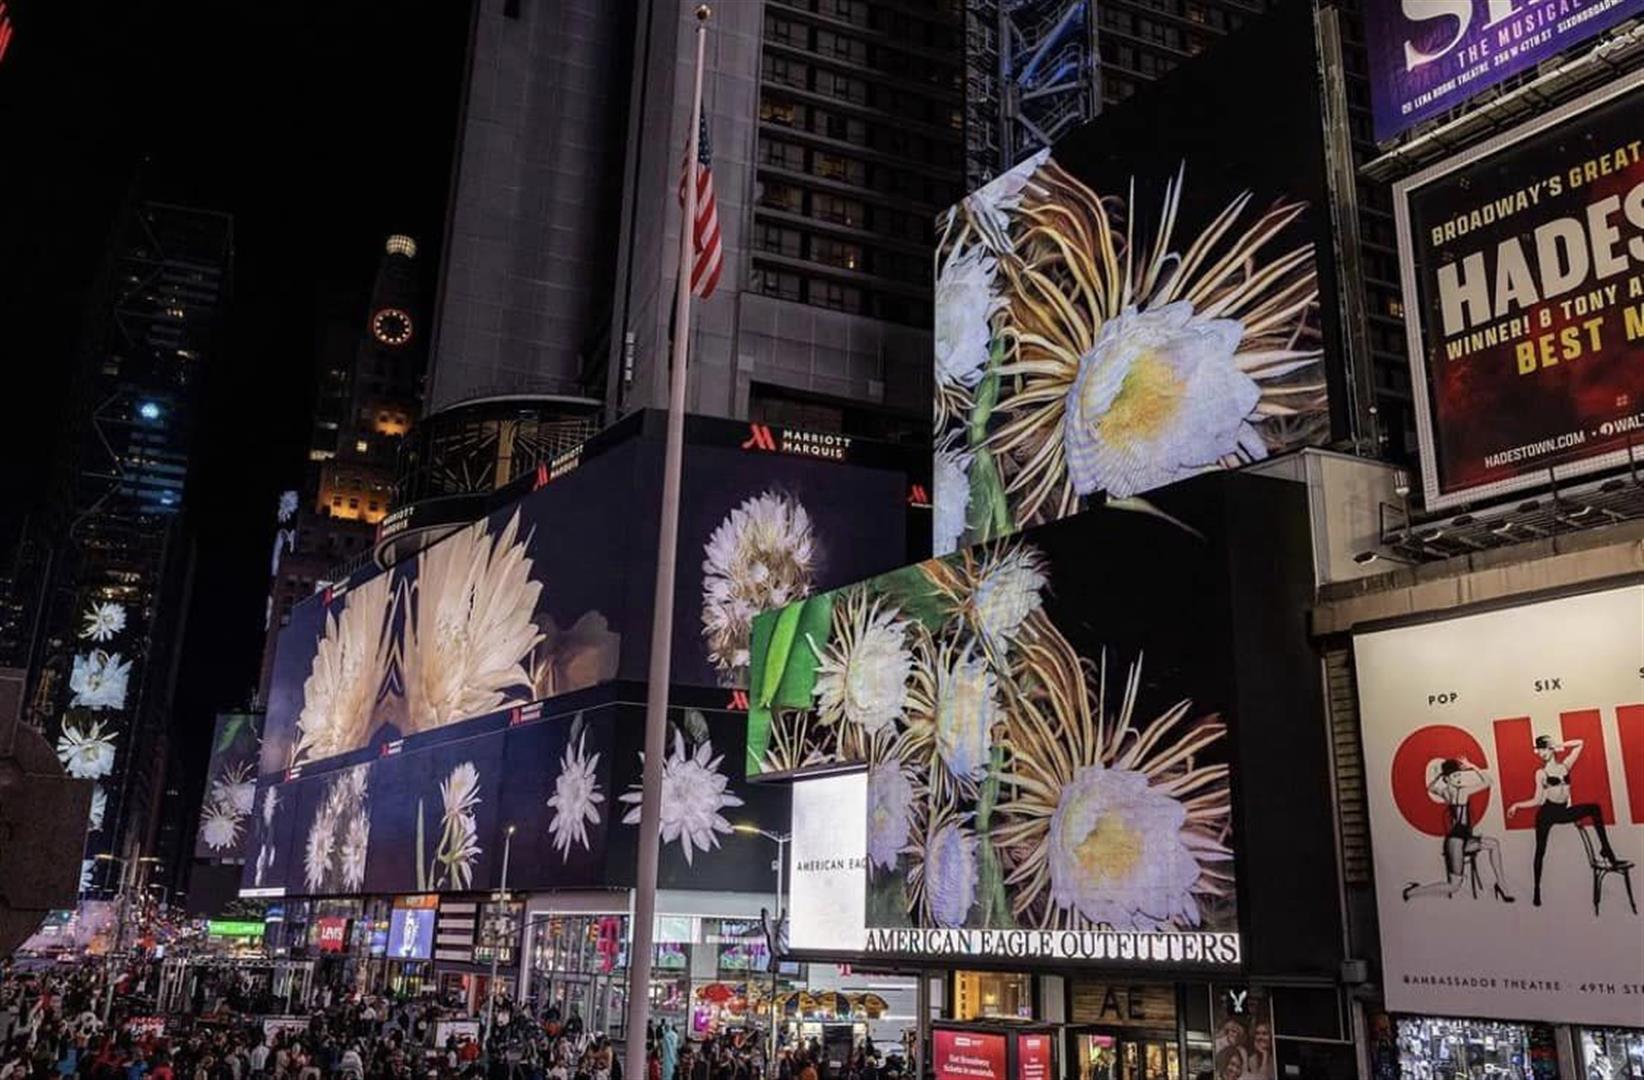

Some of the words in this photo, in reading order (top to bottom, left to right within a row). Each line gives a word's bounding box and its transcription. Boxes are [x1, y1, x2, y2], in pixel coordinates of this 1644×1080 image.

[1458, 38, 1489, 68] THE
[1497, 0, 1581, 47] MUSICAL
[1431, 176, 1563, 247] BROADWAY'S
[1568, 140, 1642, 189] GREAT
[1446, 315, 1531, 361] WINNER!
[1560, 284, 1618, 321] TONY
[1628, 276, 1644, 299] A
[1515, 317, 1604, 376] BEST
[783, 430, 851, 447] MARRIOTT
[783, 442, 843, 458] MARQUIS
[1484, 430, 1586, 469] HADESTOWN.COM
[1428, 693, 1458, 706] POP
[1534, 678, 1562, 692] SIX
[797, 859, 844, 871] AMERICAN
[866, 931, 972, 953] AMERICAN
[981, 934, 1055, 957] EAGLE
[1060, 935, 1238, 963] OUTFITTERS
[1412, 976, 1497, 988] AMBASSADOR
[1504, 979, 1561, 991] THEATRE
[1579, 983, 1616, 994] 49TH
[1100, 987, 1148, 1021] AE
